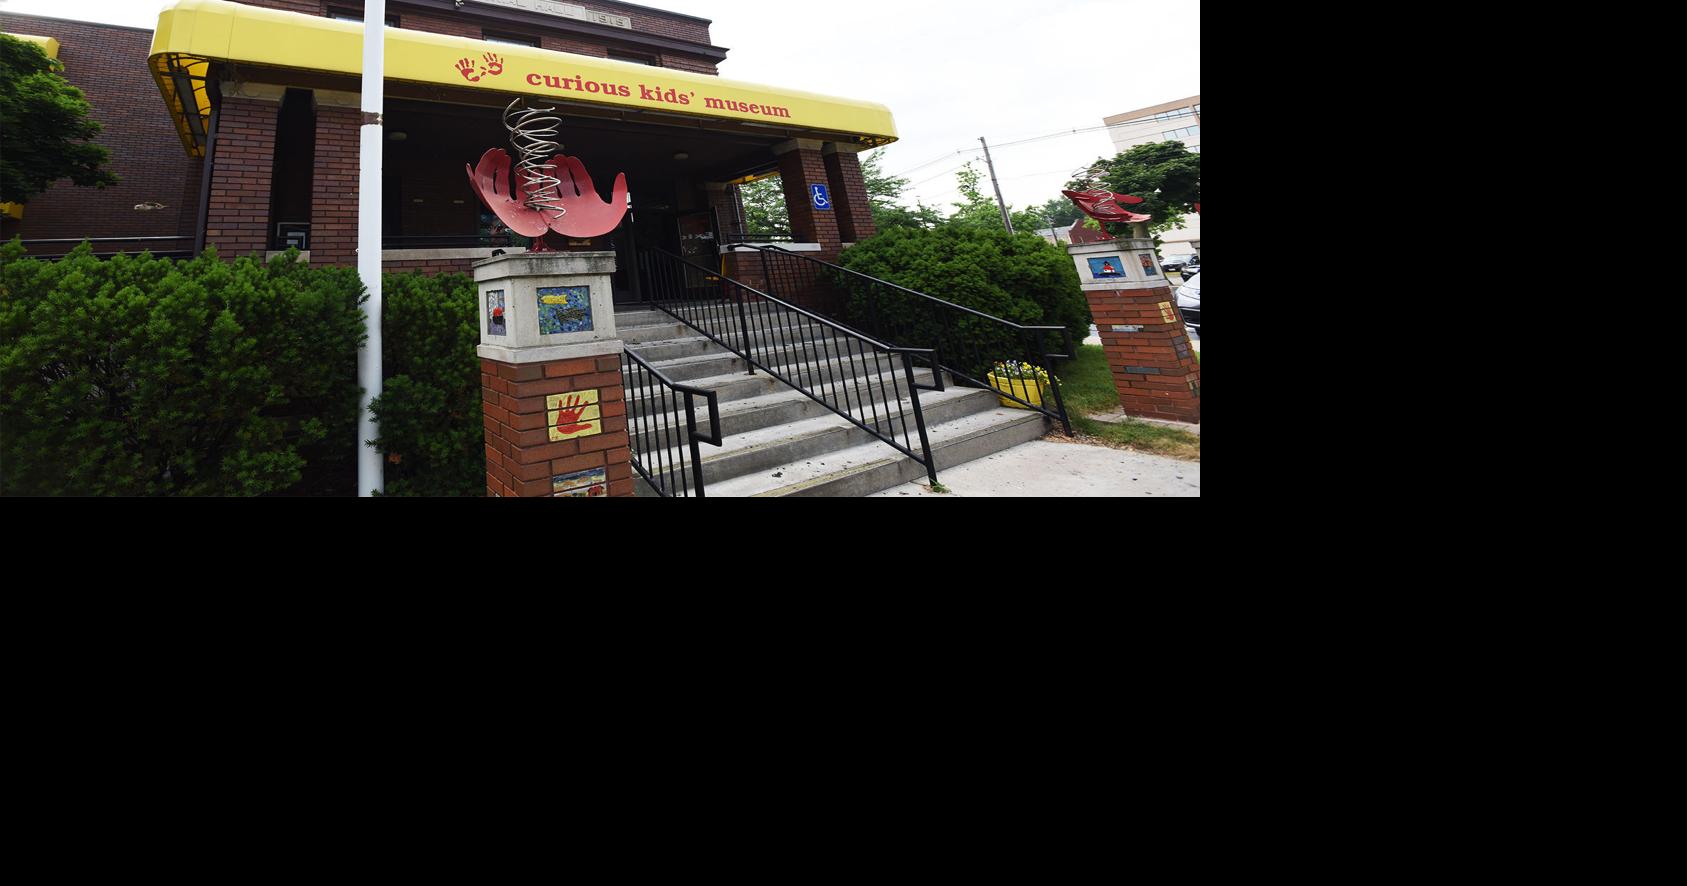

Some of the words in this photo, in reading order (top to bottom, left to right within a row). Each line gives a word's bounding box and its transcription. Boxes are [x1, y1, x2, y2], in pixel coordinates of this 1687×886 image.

[526, 73, 630, 98] curious
[639, 84, 696, 105] kids'
[704, 97, 791, 119] museum
